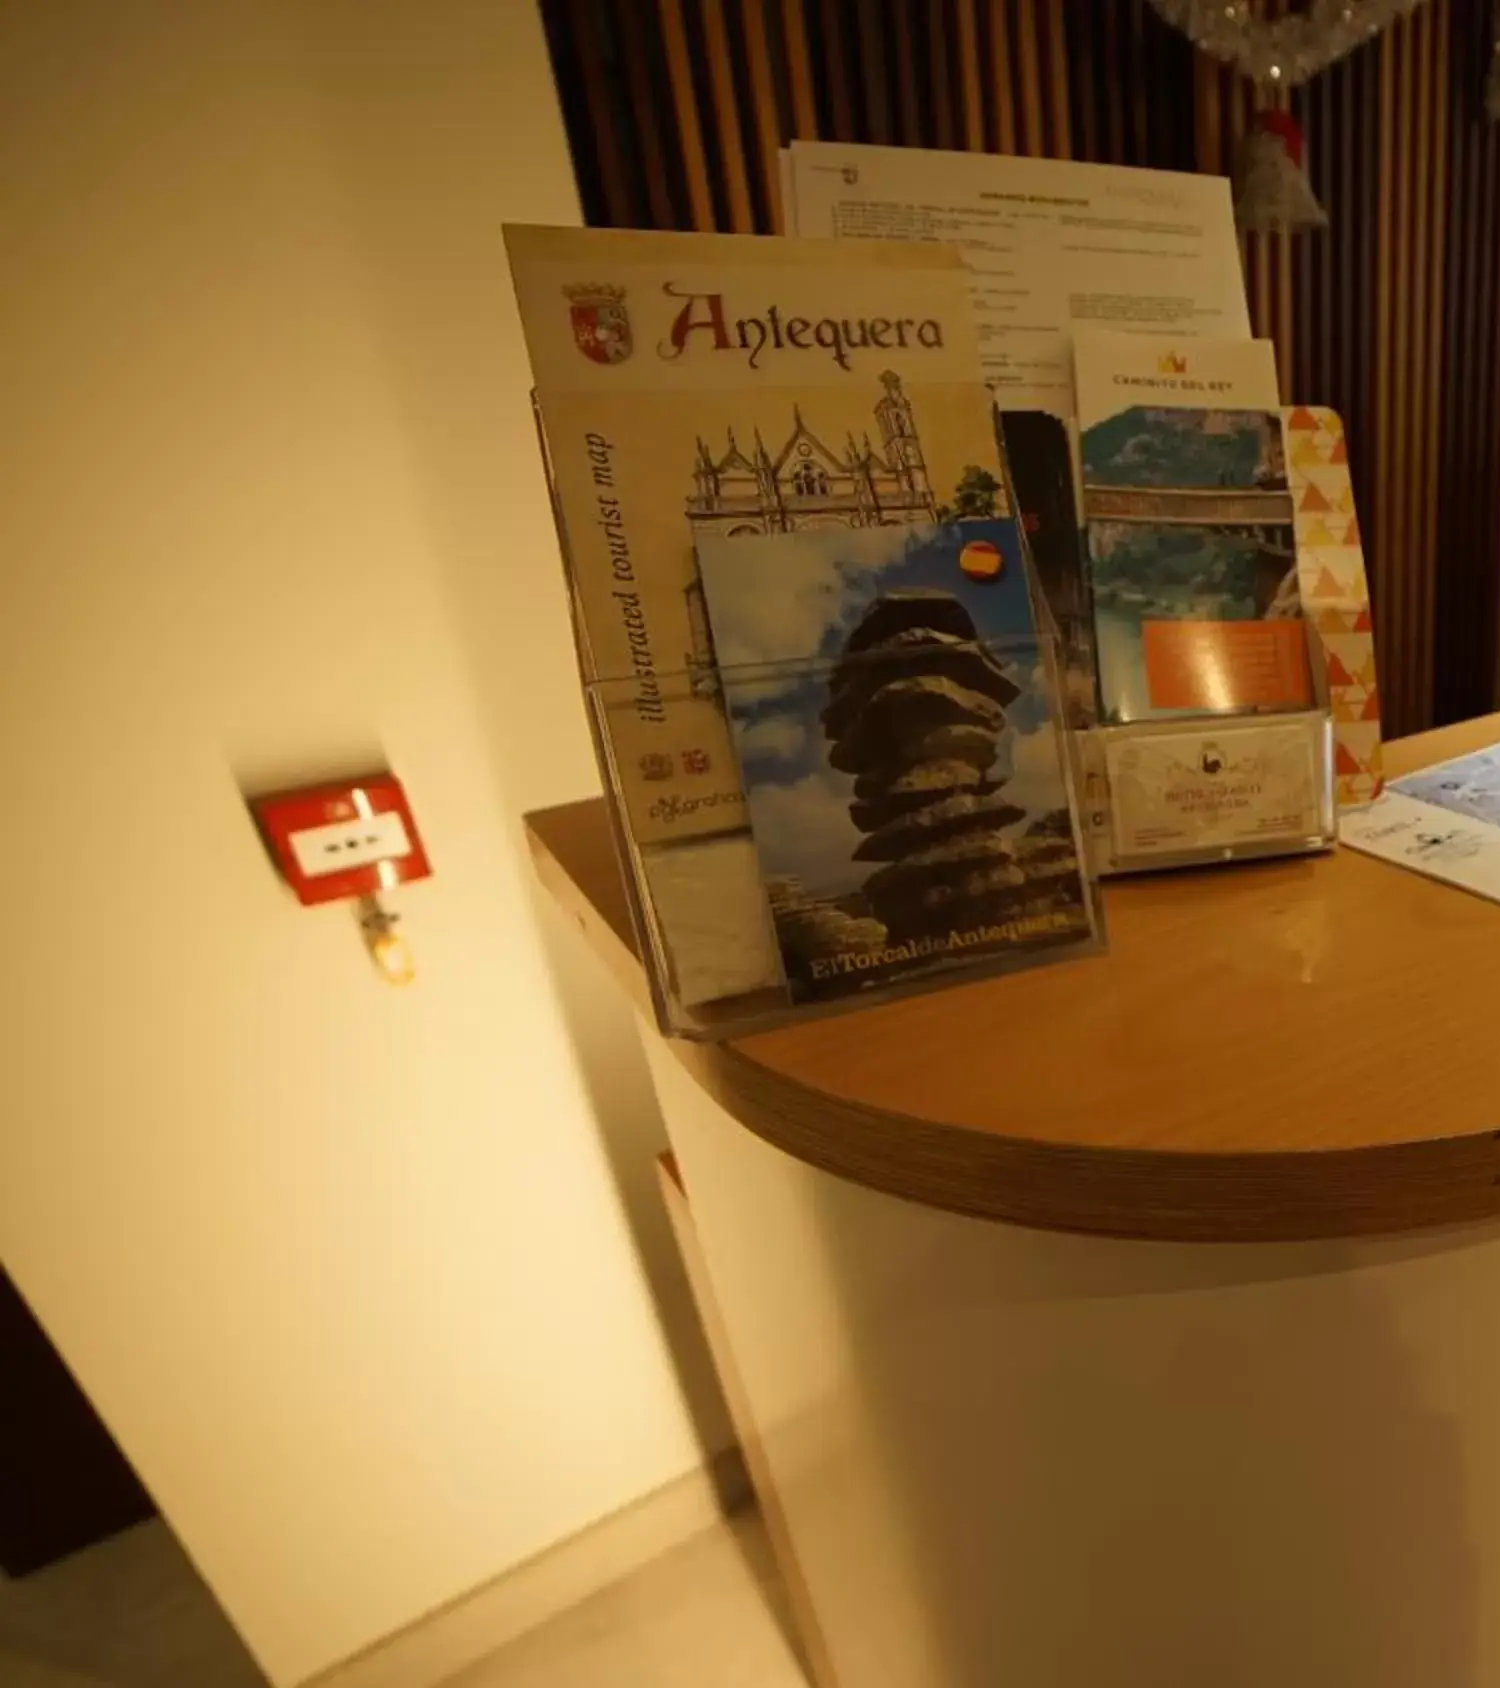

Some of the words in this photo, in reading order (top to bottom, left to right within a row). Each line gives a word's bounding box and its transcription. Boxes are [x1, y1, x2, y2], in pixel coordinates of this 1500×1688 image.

[657, 281, 944, 370] Antequera
[585, 432, 616, 488] map
[597, 496, 635, 583] tourist
[612, 591, 666, 724] illustrated
